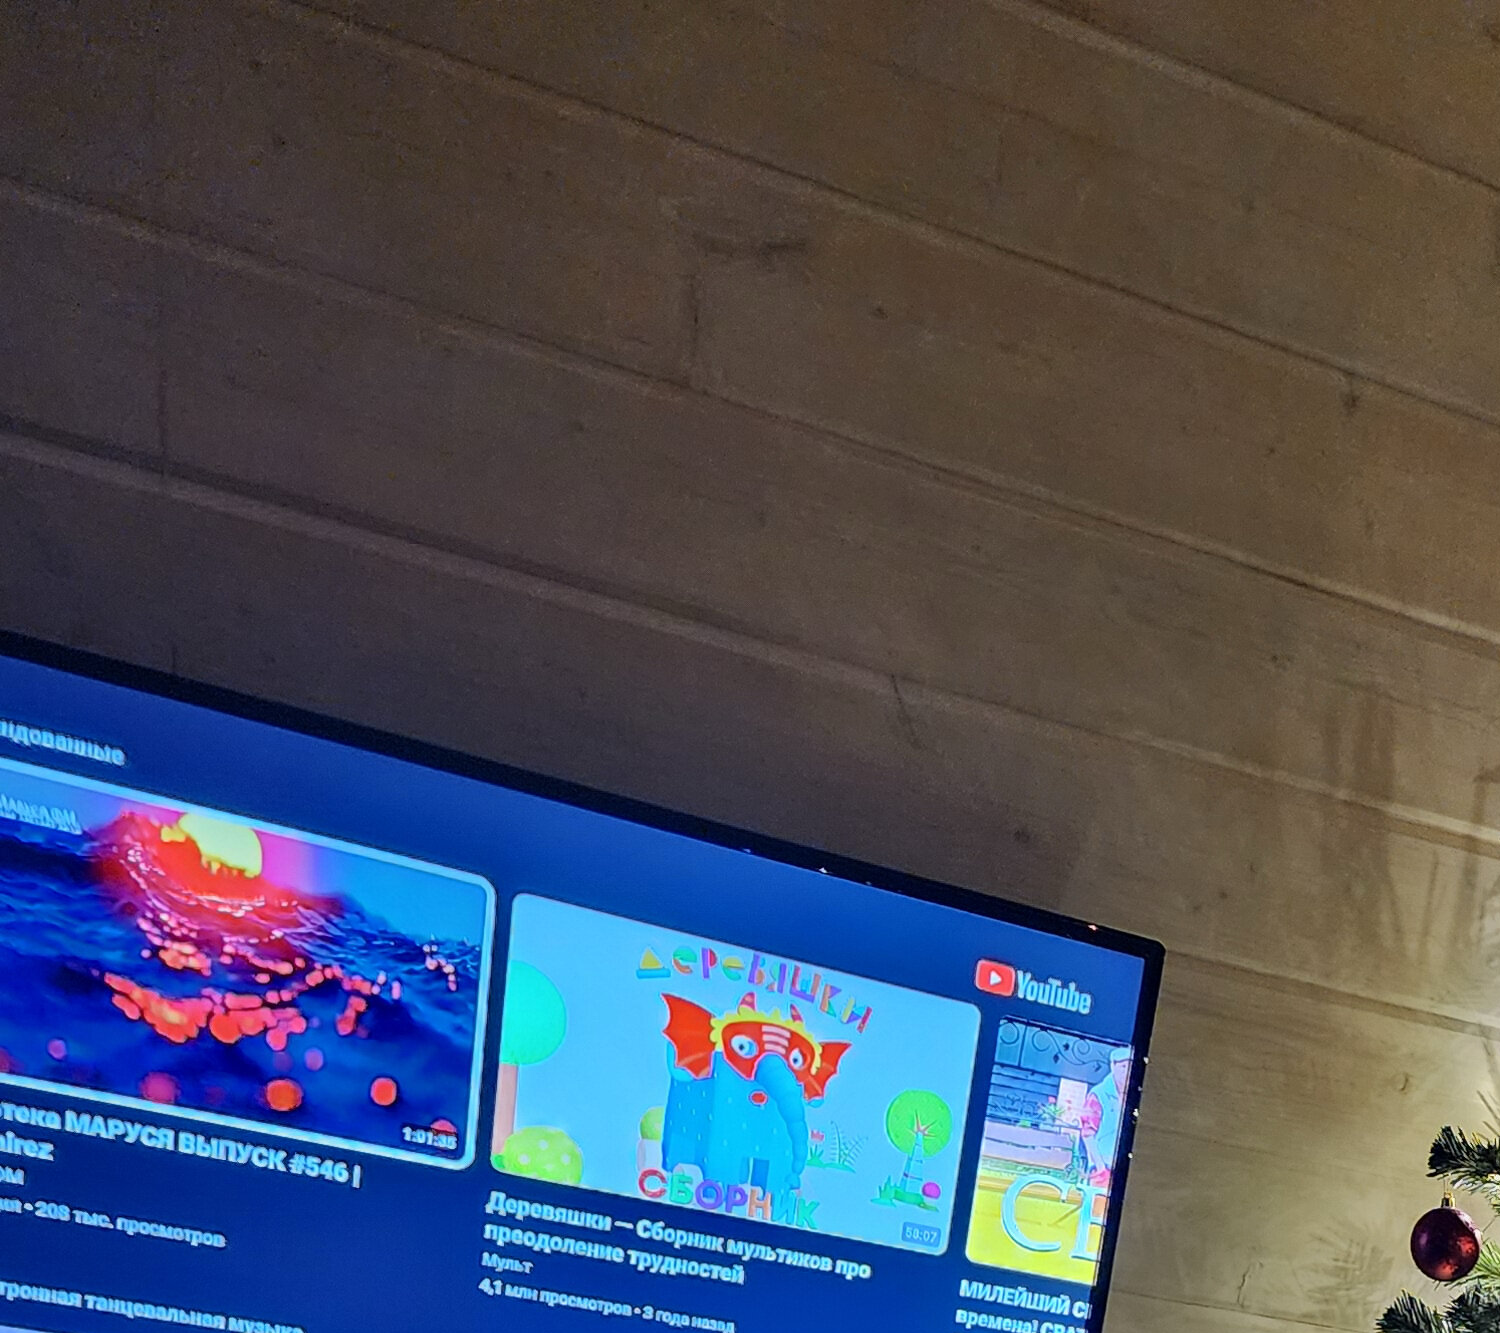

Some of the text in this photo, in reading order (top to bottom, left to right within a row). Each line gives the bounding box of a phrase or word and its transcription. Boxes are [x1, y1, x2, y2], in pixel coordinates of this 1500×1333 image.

[1016, 969, 1092, 1015] YouTube
[0, 1101, 62, 1130] тека
[64, 1109, 175, 1151] МАРУСЯ
[178, 1131, 287, 1172] ВЫПУСК
[287, 1151, 349, 1184] #546
[34, 1200, 71, 1222] 208
[71, 1209, 114, 1229] тыс.
[115, 1216, 227, 1248] просмотров
[638, 1168, 820, 1230] СБОРНИК
[483, 1223, 745, 1286] преодоление трудностей
[484, 1190, 612, 1232] Деревяшки
[636, 1218, 724, 1254] Сборник
[726, 1239, 833, 1272] мультиков
[834, 1259, 872, 1281] про
[481, 1251, 534, 1274] Мульт
[84, 1294, 226, 1331] танцевальная
[478, 1277, 504, 1297] 4,1
[504, 1283, 538, 1302] млн
[539, 1290, 633, 1317] просмотров
[642, 1305, 655, 1321] 3
[655, 1309, 690, 1329] года
[959, 1279, 1072, 1317] МИЛЕЙШИЙ
